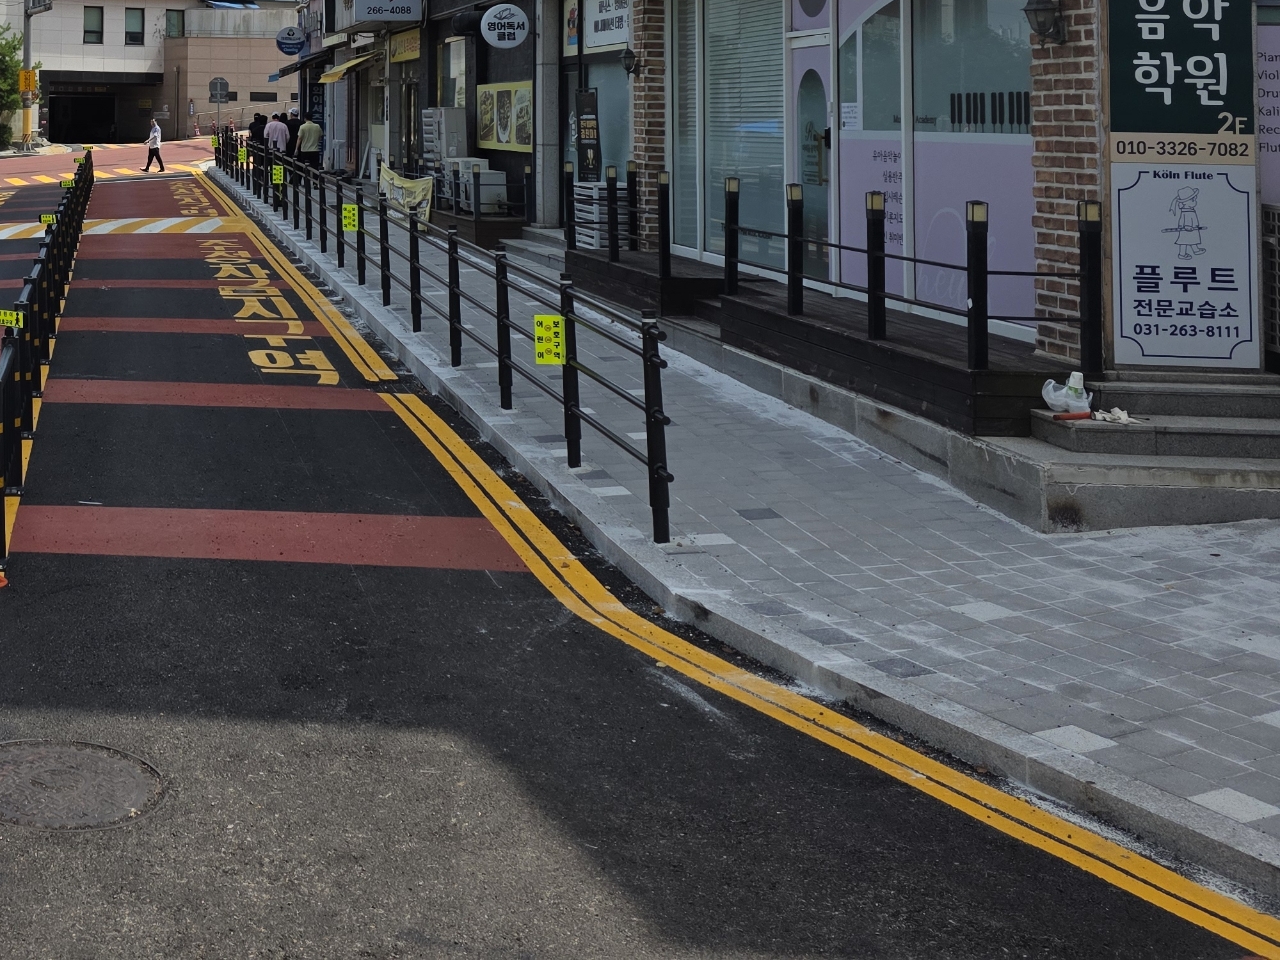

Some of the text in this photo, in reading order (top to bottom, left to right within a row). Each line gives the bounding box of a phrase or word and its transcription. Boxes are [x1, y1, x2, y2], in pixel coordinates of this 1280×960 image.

[366, 6, 412, 15] 266-4088
[487, 21, 525, 31] 영어독서
[1132, 51, 1228, 106] 학원
[1216, 111, 1248, 135] 2F
[1116, 140, 1249, 157] 010-3326-7082
[1153, 169, 1214, 180] Köln Flute
[1133, 265, 1238, 293] 플루트
[196, 239, 340, 385] 주정차금지구역
[1133, 299, 1239, 319] 전문교습소
[1133, 323, 1240, 338] 031-263-8111
